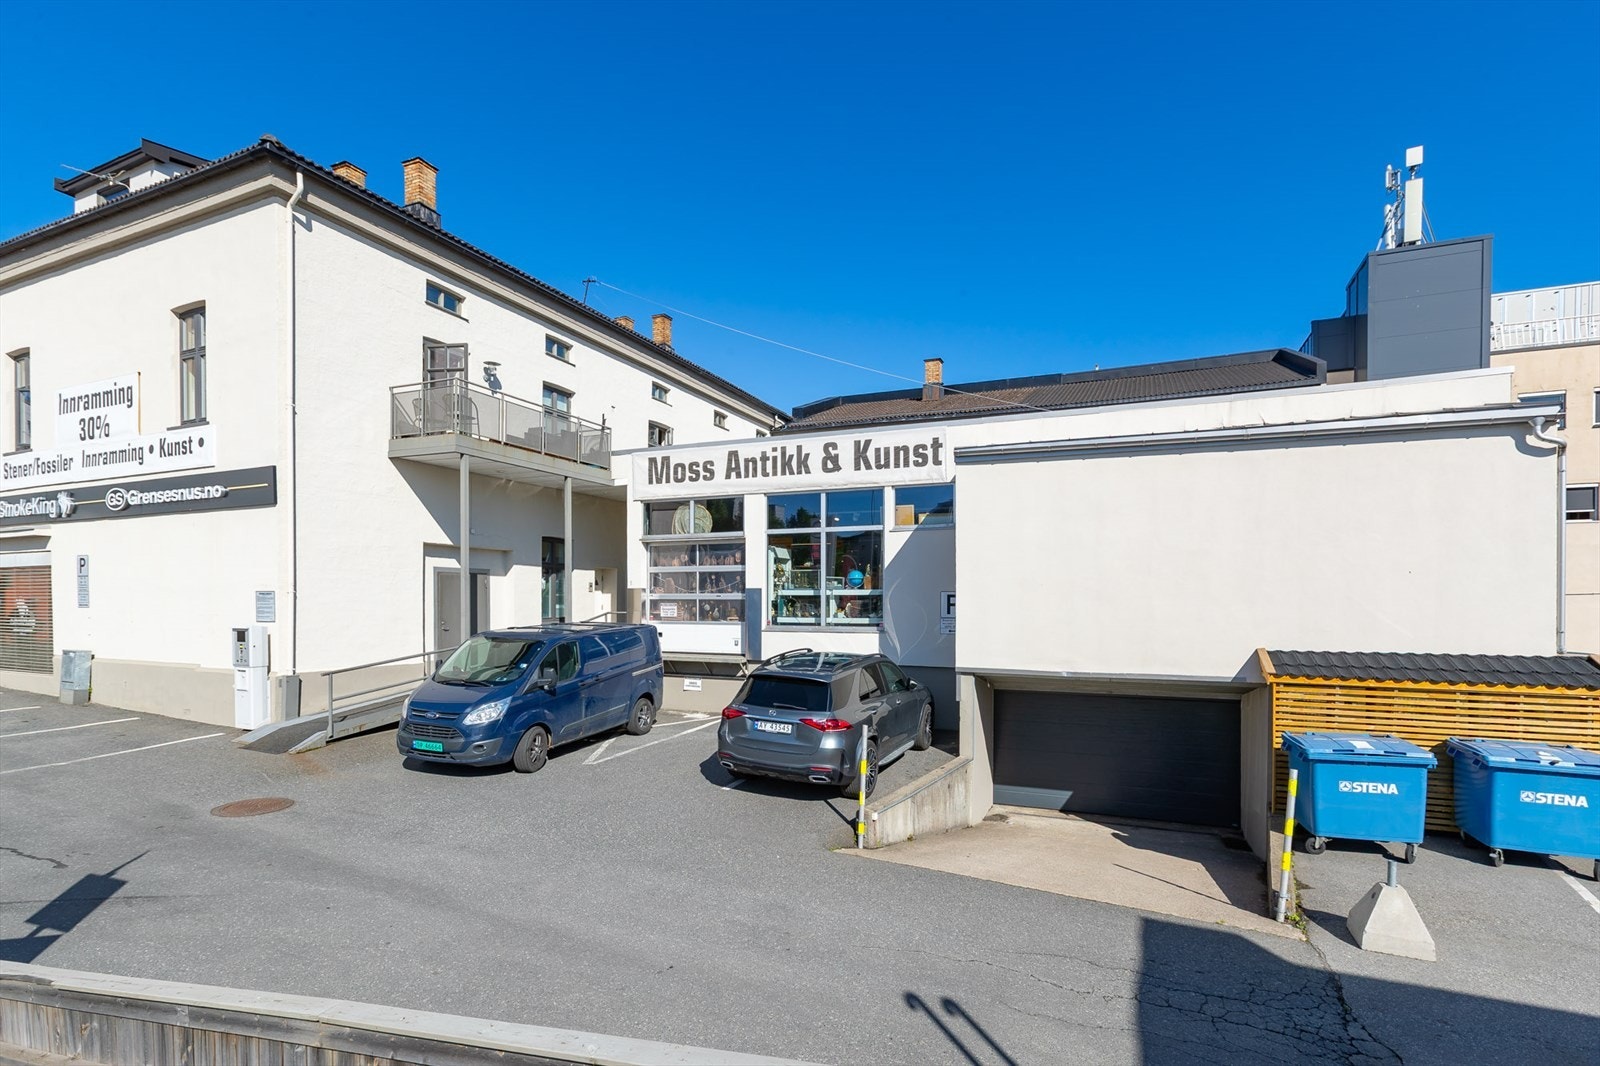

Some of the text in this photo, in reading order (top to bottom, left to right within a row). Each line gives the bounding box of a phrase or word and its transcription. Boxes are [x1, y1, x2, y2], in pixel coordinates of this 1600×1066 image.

[58, 382, 133, 415] Innramming
[79, 414, 110, 441] 30%
[3, 436, 193, 479] Stener/Fossiler Innramming Kunst
[648, 437, 943, 485] Moss Antikk & Kunst
[107, 484, 222, 506] GS Grensesnus.no
[0, 496, 58, 518] SmokeKing
[79, 557, 86, 574] P
[1351, 781, 1398, 795] STENA
[1535, 792, 1588, 808] STENA
